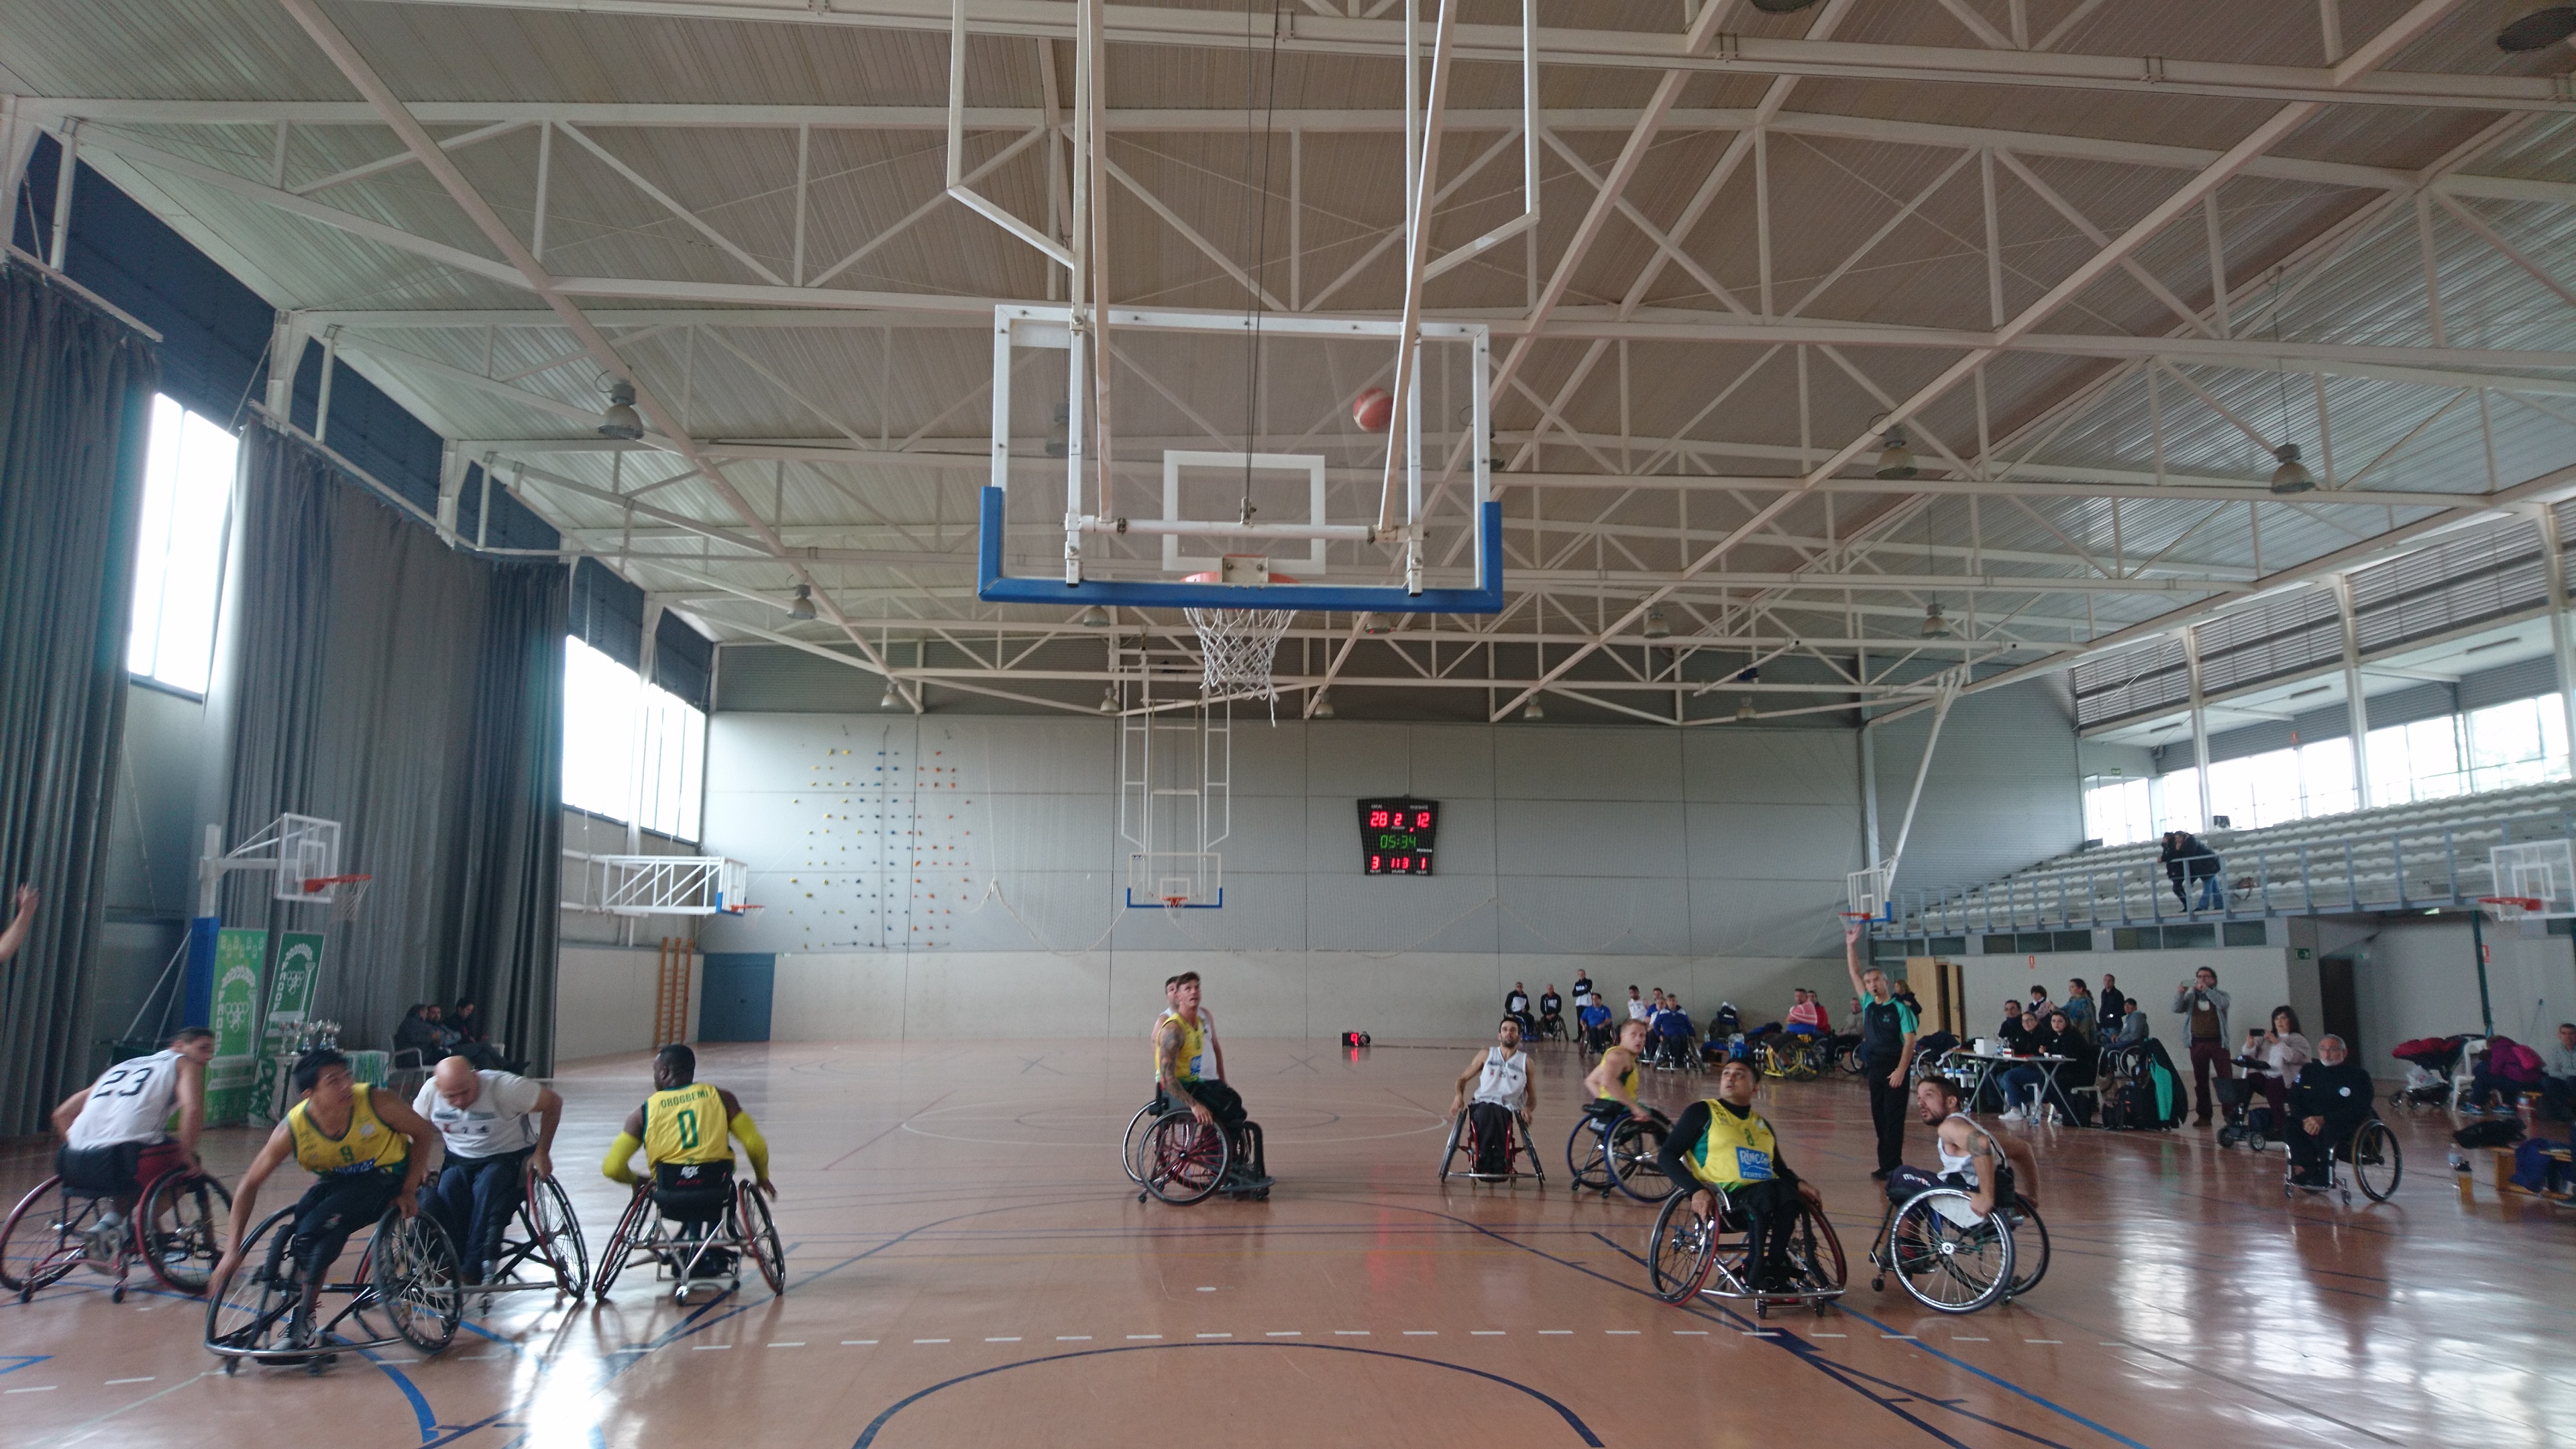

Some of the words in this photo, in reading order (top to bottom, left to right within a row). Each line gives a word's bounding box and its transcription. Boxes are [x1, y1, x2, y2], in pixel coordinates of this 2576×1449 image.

[1370, 811, 1388, 827] 28
[1393, 812, 1403, 826] 2
[1417, 812, 1430, 828] 12
[1380, 835, 1416, 849] 05:34
[1371, 855, 1380, 869] 3
[1421, 857, 1427, 869] 1
[91, 1067, 154, 1100] 23
[660, 1089, 709, 1108] OROGBEMI
[677, 1109, 699, 1149] 0
